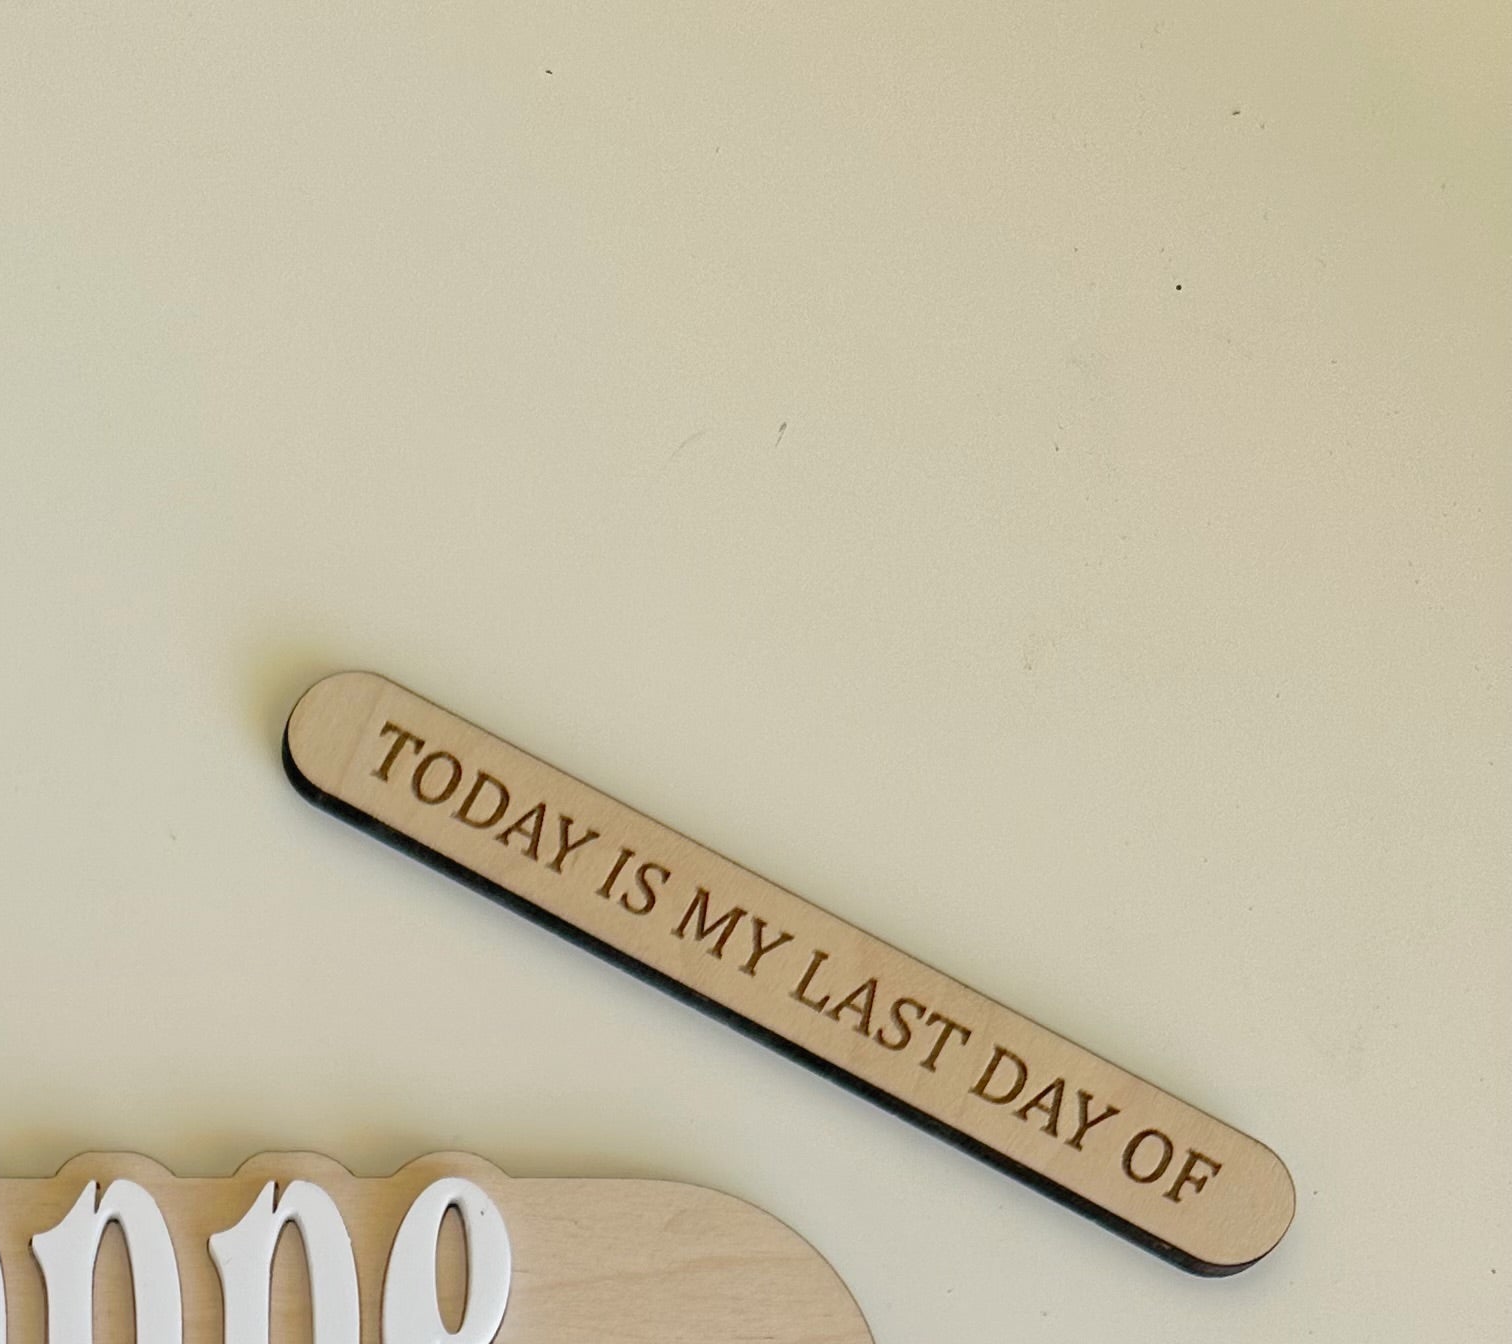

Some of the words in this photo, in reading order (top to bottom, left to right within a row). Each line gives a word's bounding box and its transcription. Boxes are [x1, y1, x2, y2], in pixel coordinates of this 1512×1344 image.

[370, 720, 600, 875] TODAY
[596, 847, 671, 916] IS
[671, 886, 795, 978] MY
[789, 949, 973, 1073] LAST
[967, 1044, 1121, 1153] DAY
[1121, 1128, 1223, 1204] OF
